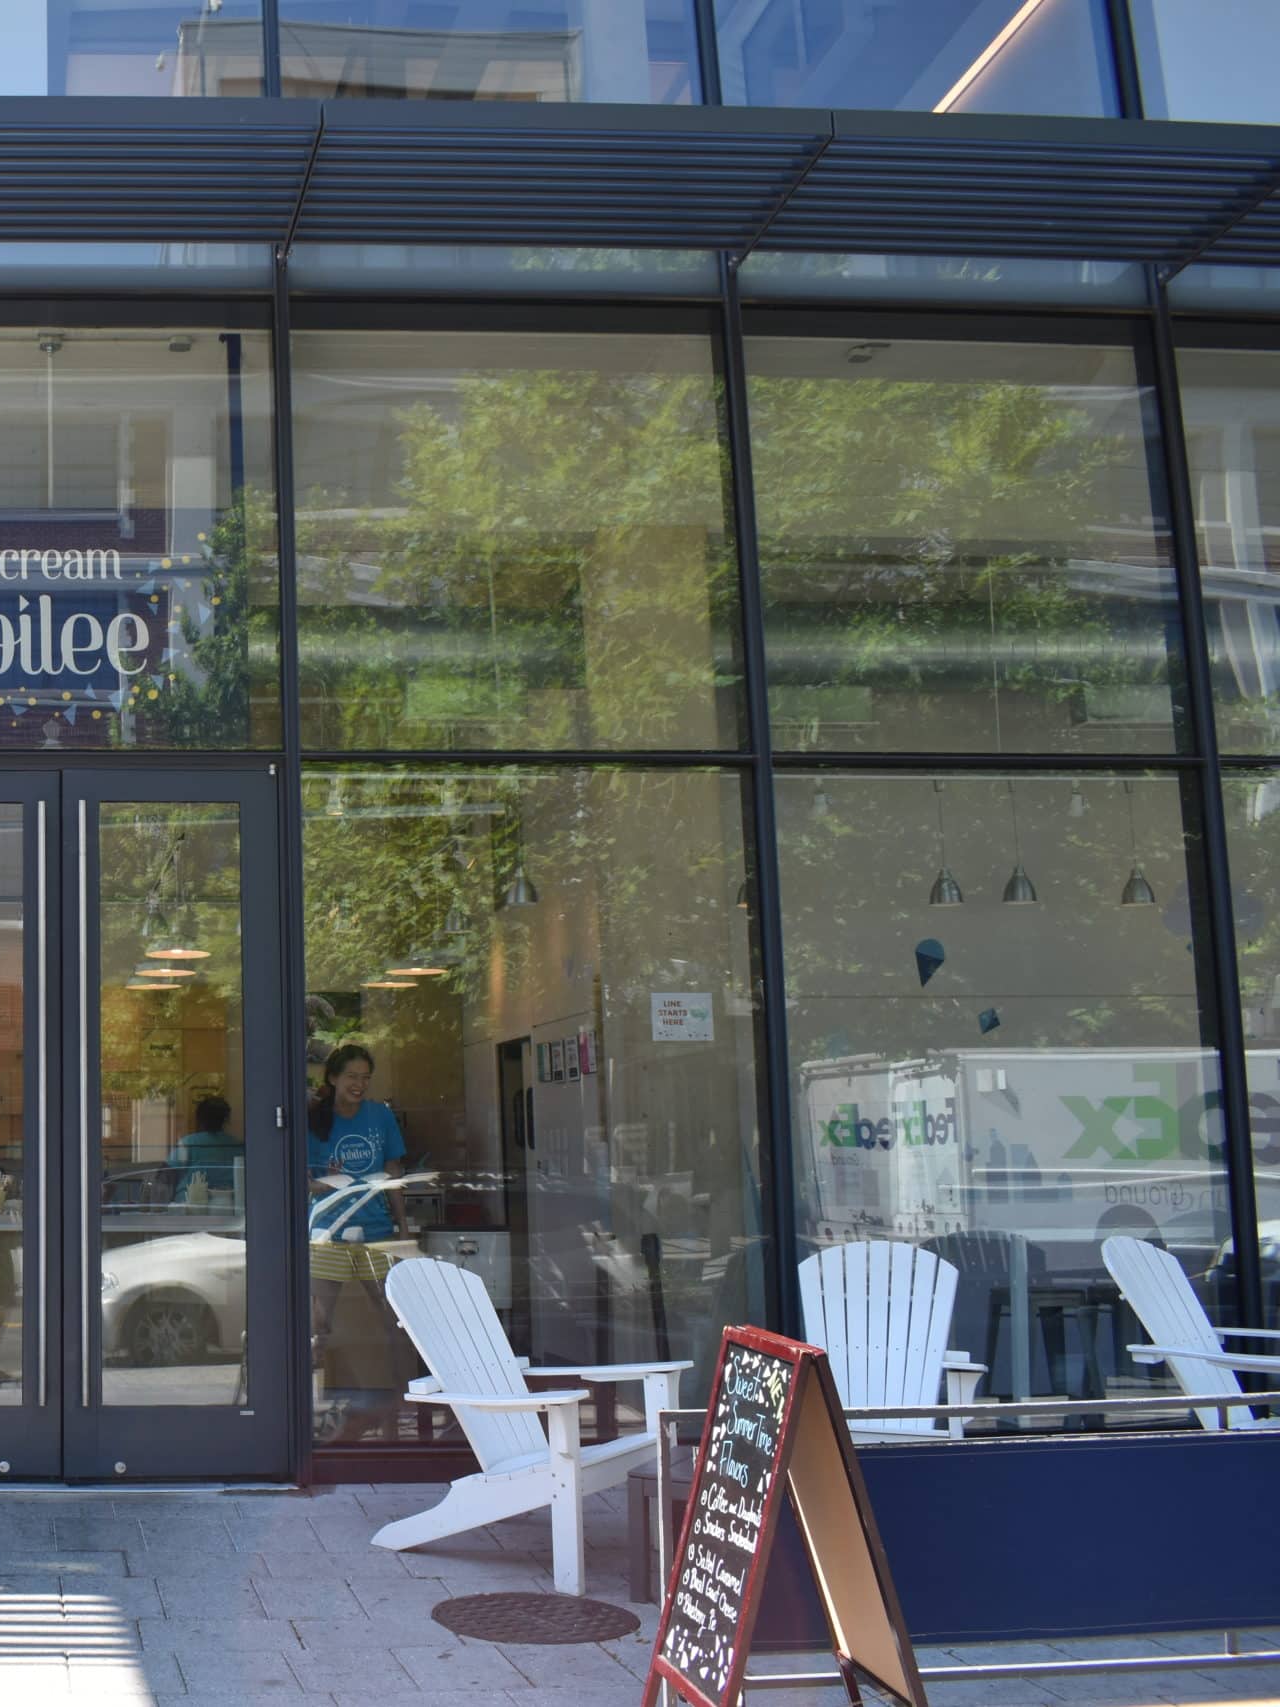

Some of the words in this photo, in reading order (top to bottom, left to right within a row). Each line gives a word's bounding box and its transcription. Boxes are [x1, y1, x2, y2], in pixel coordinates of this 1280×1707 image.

[0, 547, 122, 580] cream
[658, 1009, 688, 1017] STARTS
[663, 1000, 681, 1008] LINE
[662, 1018, 684, 1026] HERE
[726, 1355, 761, 1402] Sweet
[708, 1482, 729, 1514] Coffee
[695, 1543, 717, 1577] Salted
[715, 1559, 746, 1597] Caramel
